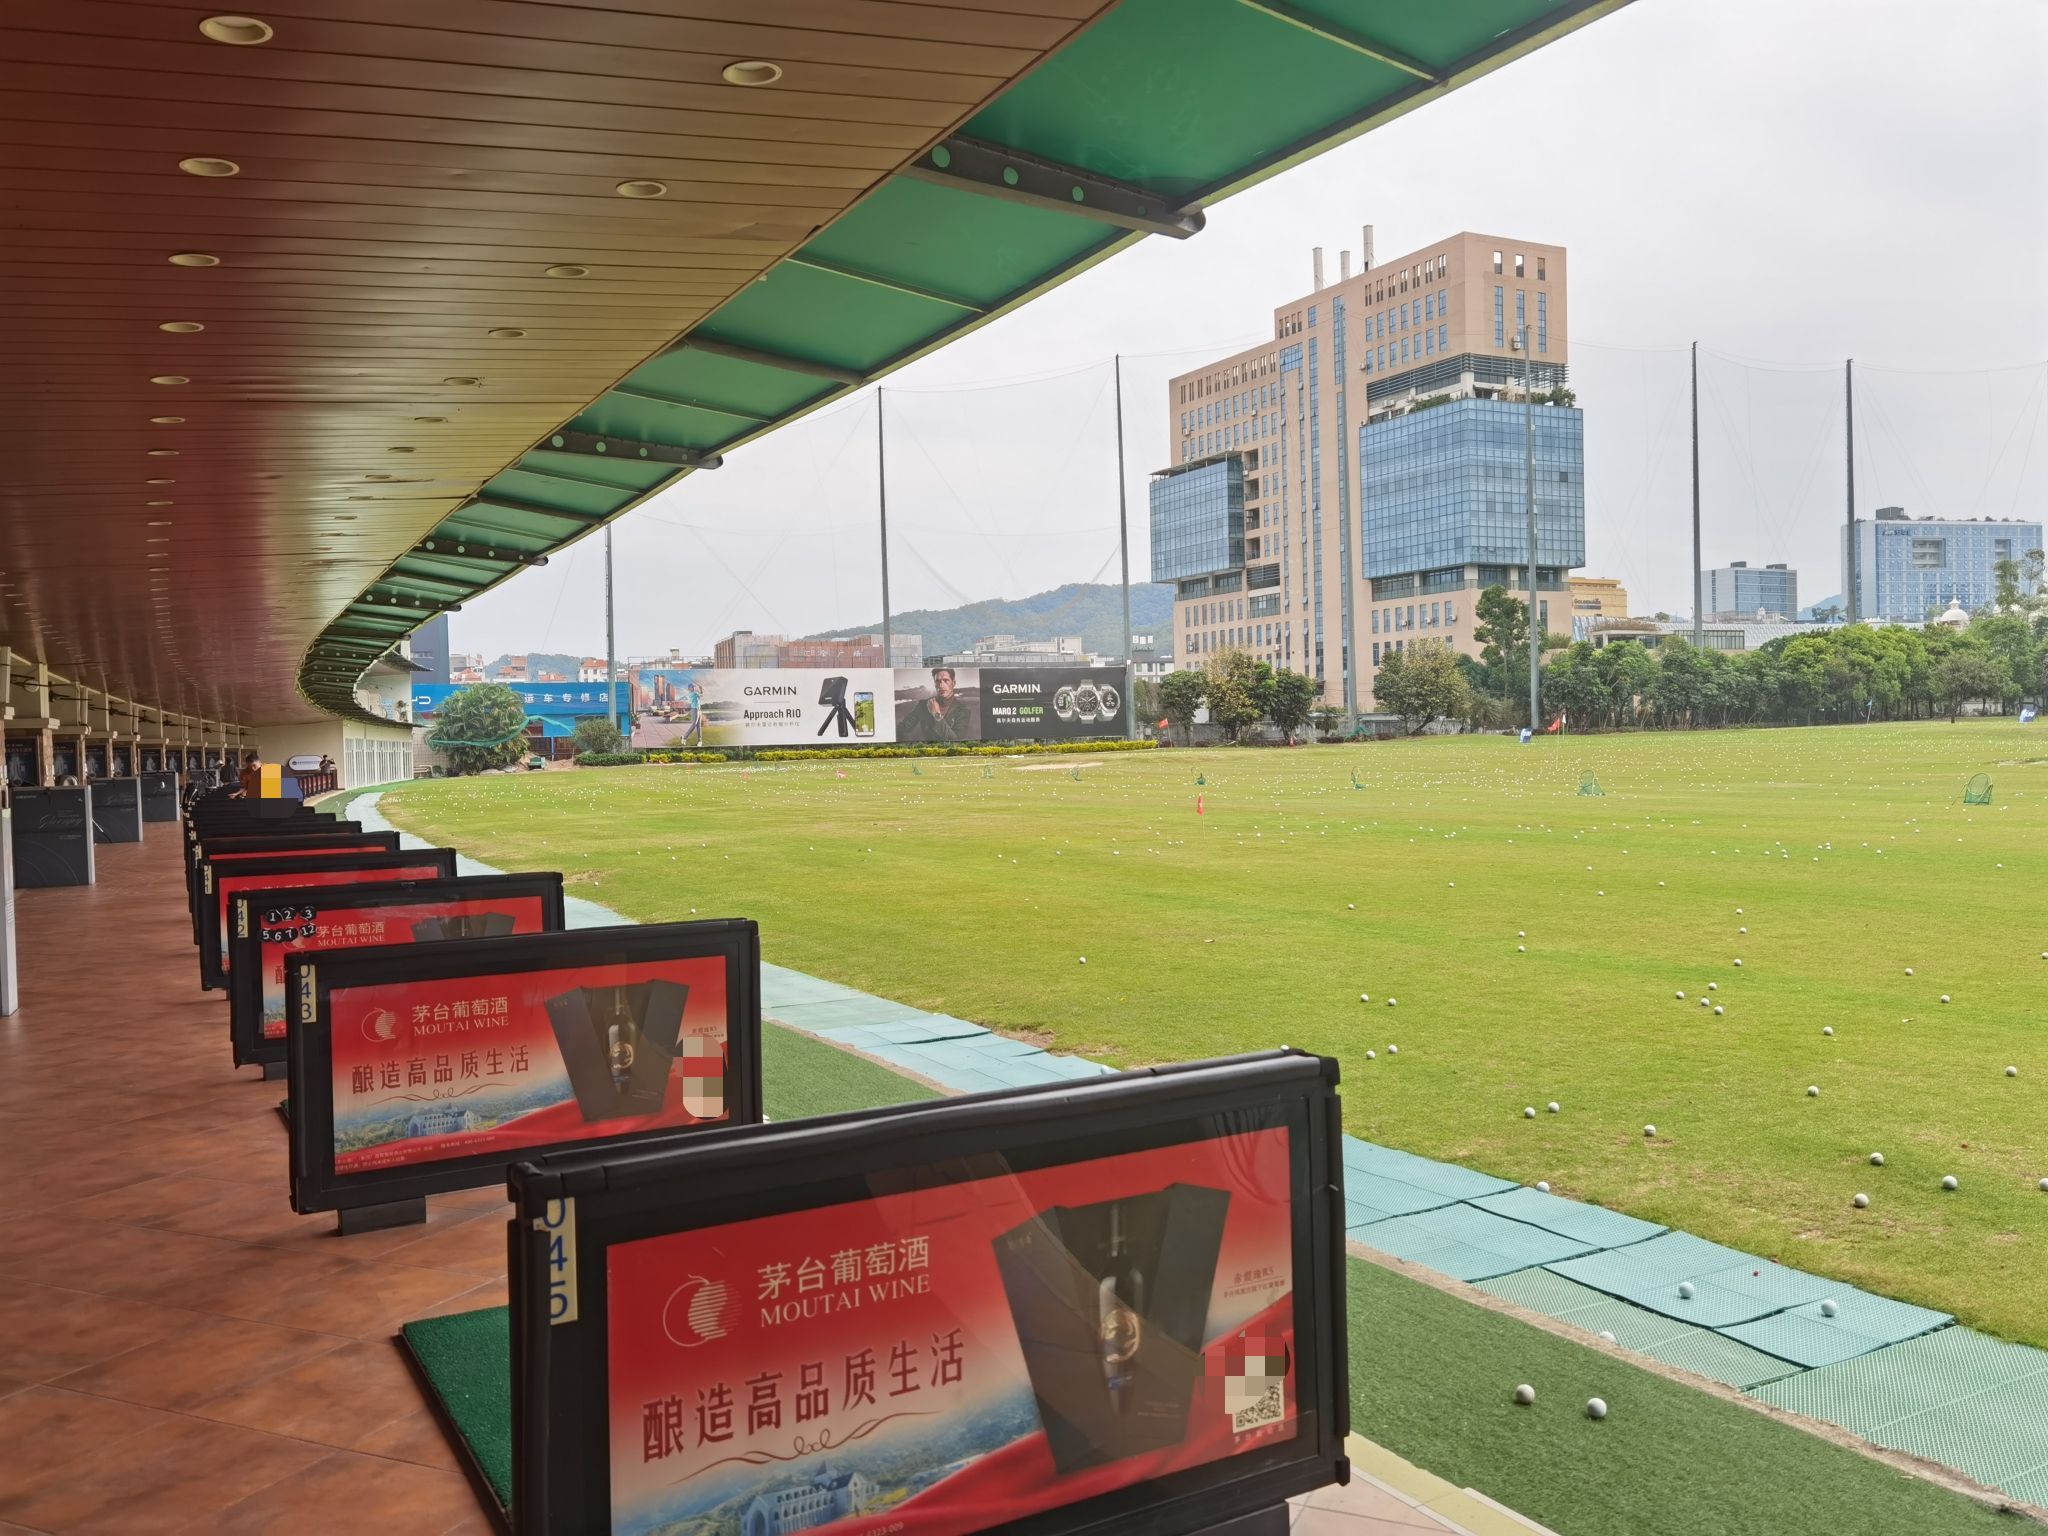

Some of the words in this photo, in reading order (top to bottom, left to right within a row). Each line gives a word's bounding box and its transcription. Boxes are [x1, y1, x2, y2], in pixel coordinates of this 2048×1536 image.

[743, 686, 797, 696] GARMIN
[992, 684, 1041, 694] GARMIN
[743, 709, 784, 721] Approach
[1012, 707, 1017, 715] 2
[1019, 706, 1044, 715] GOLFER
[270, 912, 276, 921] 1
[284, 910, 292, 920] 2
[305, 909, 312, 919] 3
[262, 930, 270, 940] 5
[274, 931, 281, 941] 6
[285, 929, 293, 939] 7
[301, 925, 315, 936] 12
[316, 921, 385, 938] 茅台葡萄酒
[318, 936, 358, 947] MOUTAI
[359, 934, 385, 944] WINE
[412, 996, 509, 1024] 茅台葡萄酒
[414, 1021, 469, 1037] MOUTAI
[473, 1015, 509, 1029] WINE
[351, 1044, 530, 1095] 酿造高品质生活
[757, 1235, 930, 1301] 茅台葡萄酒
[760, 1289, 860, 1328] MOUTAI
[868, 1273, 931, 1302] WINE
[642, 1327, 965, 1464] 酿造高品质生活
